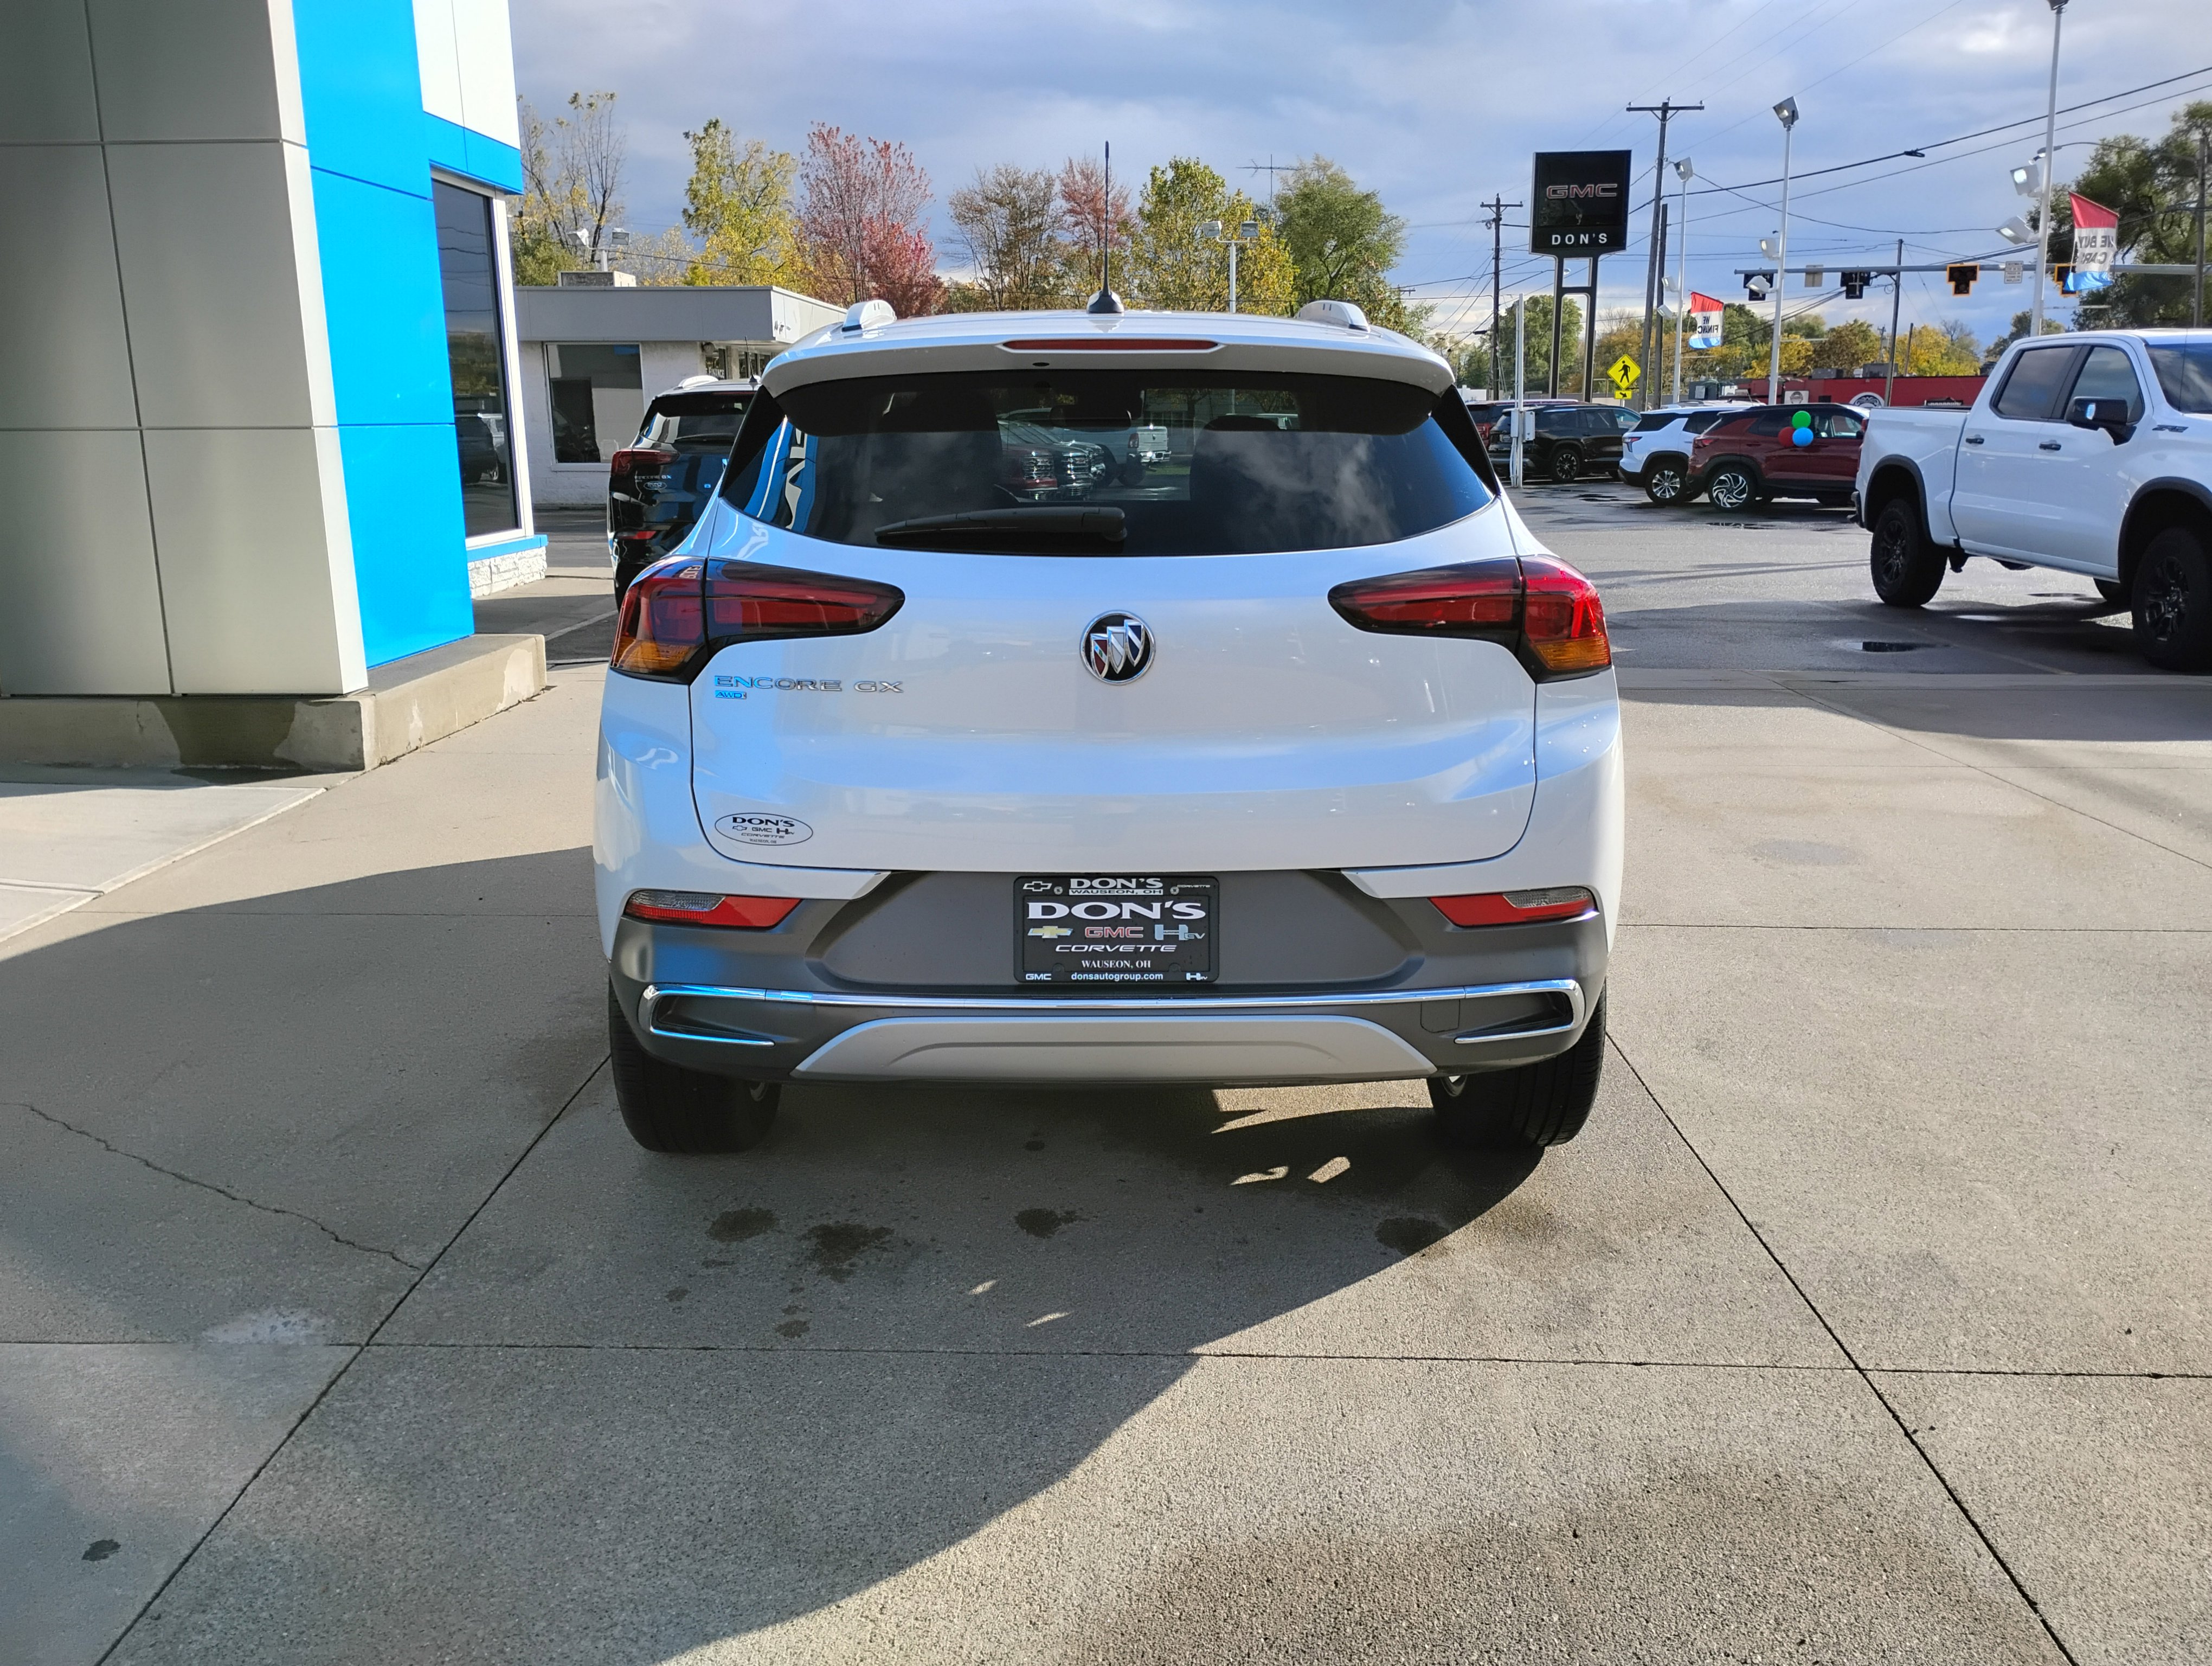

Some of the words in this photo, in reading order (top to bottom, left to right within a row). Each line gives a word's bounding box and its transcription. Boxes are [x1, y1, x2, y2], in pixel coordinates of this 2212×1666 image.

[1546, 183, 1618, 199] GMC
[1552, 233, 1607, 245] DON'S
[714, 675, 842, 692] ENCORE
[854, 680, 904, 693] GX
[732, 816, 795, 828] DON'S
[1070, 878, 1163, 889] DON'S
[1026, 900, 1206, 920] DON'S
[1085, 926, 1144, 938] GMC
[1081, 960, 1134, 969] WAUSEON,
[1136, 960, 1151, 969] OH
[1071, 972, 1163, 982] donsautogroup.com
